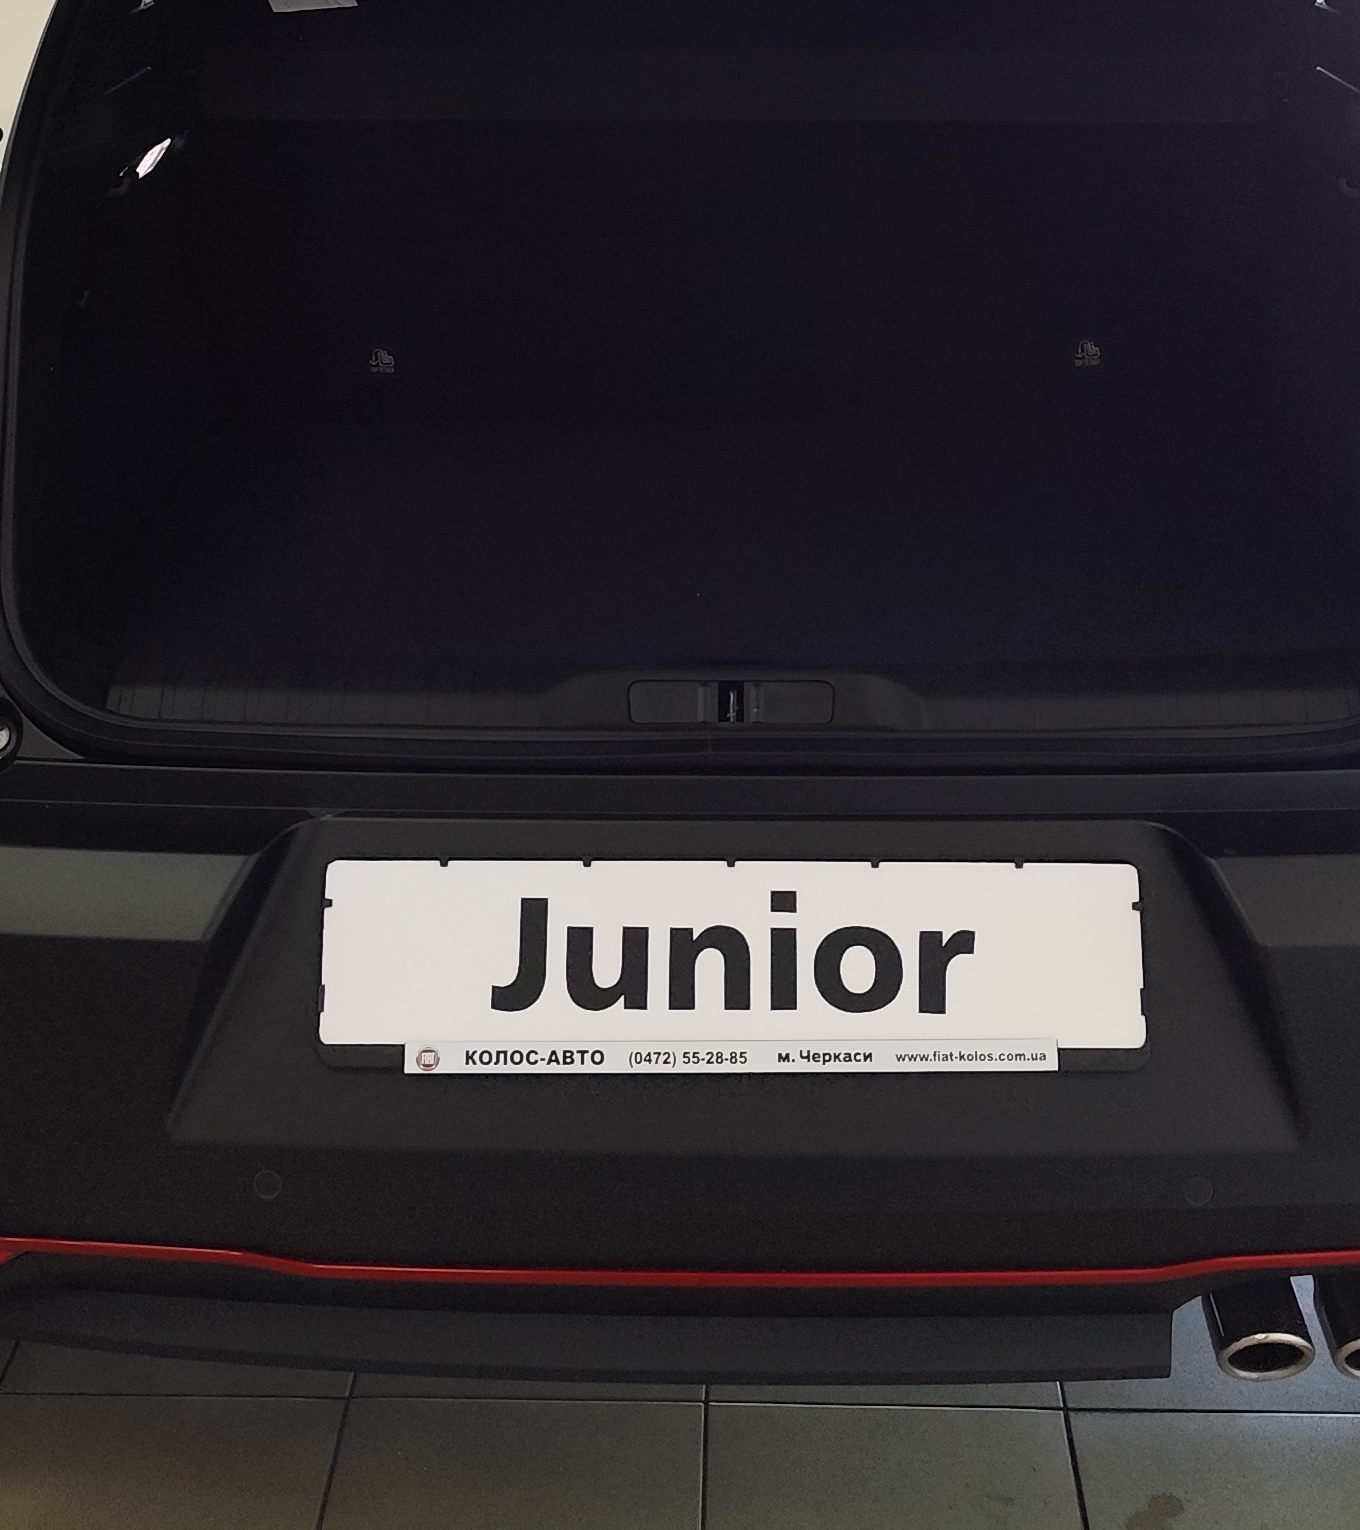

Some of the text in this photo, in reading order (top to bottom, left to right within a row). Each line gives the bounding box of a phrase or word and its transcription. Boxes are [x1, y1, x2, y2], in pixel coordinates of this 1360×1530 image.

[489, 890, 977, 1015] Junior
[464, 1049, 1048, 1069] КОЛОС-АВТО (0472) 55-28-85 м. Черкаси www.fiat-kolos.com.ua
